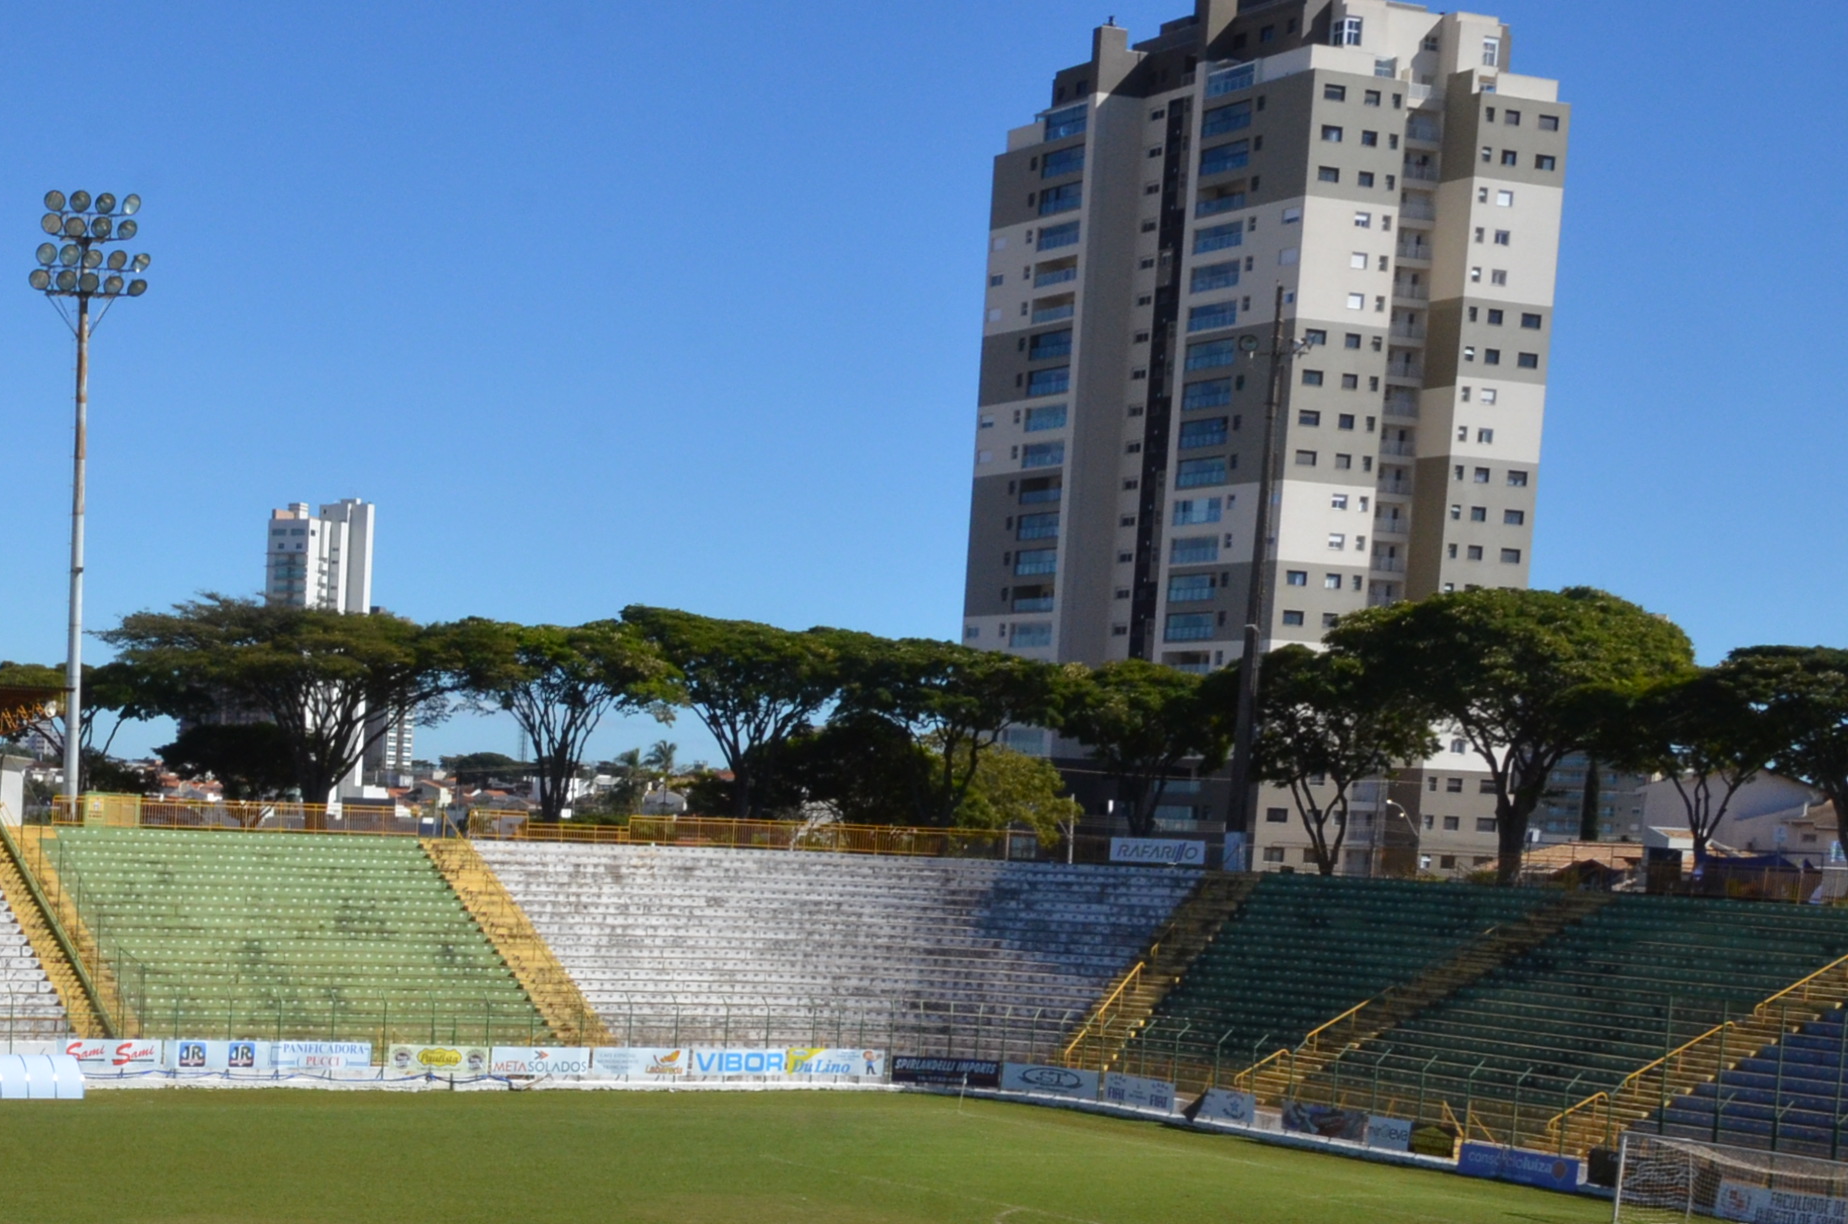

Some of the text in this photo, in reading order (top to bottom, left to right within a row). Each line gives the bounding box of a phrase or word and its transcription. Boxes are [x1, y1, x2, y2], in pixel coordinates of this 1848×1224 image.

[66, 1042, 155, 1065] Sami Sami
[283, 1043, 365, 1054] PANIFICADORA
[306, 1056, 340, 1067] PUCCI
[696, 1053, 784, 1072] VIBOR
[895, 1059, 997, 1074] SPIRLANDELLI IMPORTS
